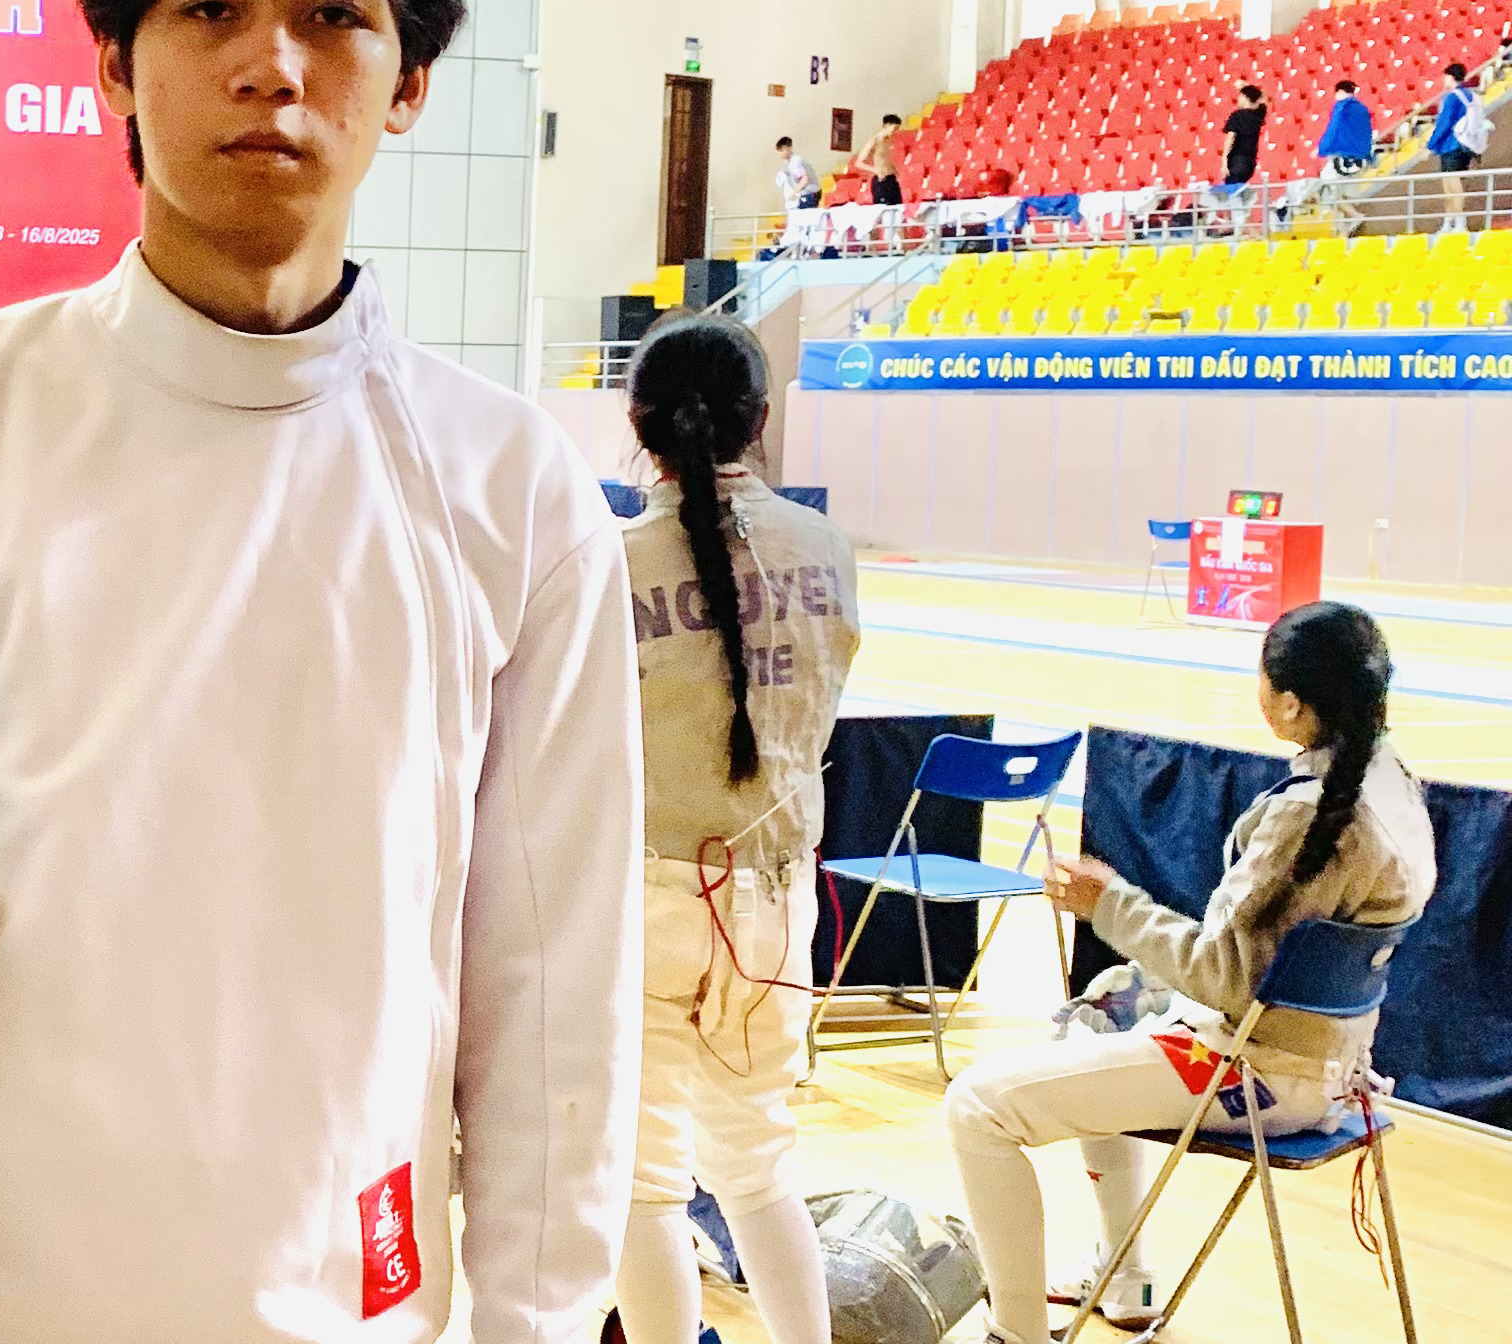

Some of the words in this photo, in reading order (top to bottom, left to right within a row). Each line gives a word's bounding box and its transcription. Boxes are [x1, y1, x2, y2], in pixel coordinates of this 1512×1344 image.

[5, 83, 103, 135] GIA
[20, 226, 101, 245] 16/8/2025
[880, 352, 935, 379] CHÚC
[939, 352, 982, 379] CÁC
[987, 351, 1029, 382] VẬN
[1034, 351, 1094, 382] ĐỘNG
[1099, 351, 1151, 379] VIÊN
[1157, 355, 1195, 379] THI
[1200, 347, 1248, 379] ĐẤU
[1255, 355, 1303, 383] ĐẠT
[1309, 349, 1391, 379] THÀNH
[1399, 348, 1457, 379] TÍCH
